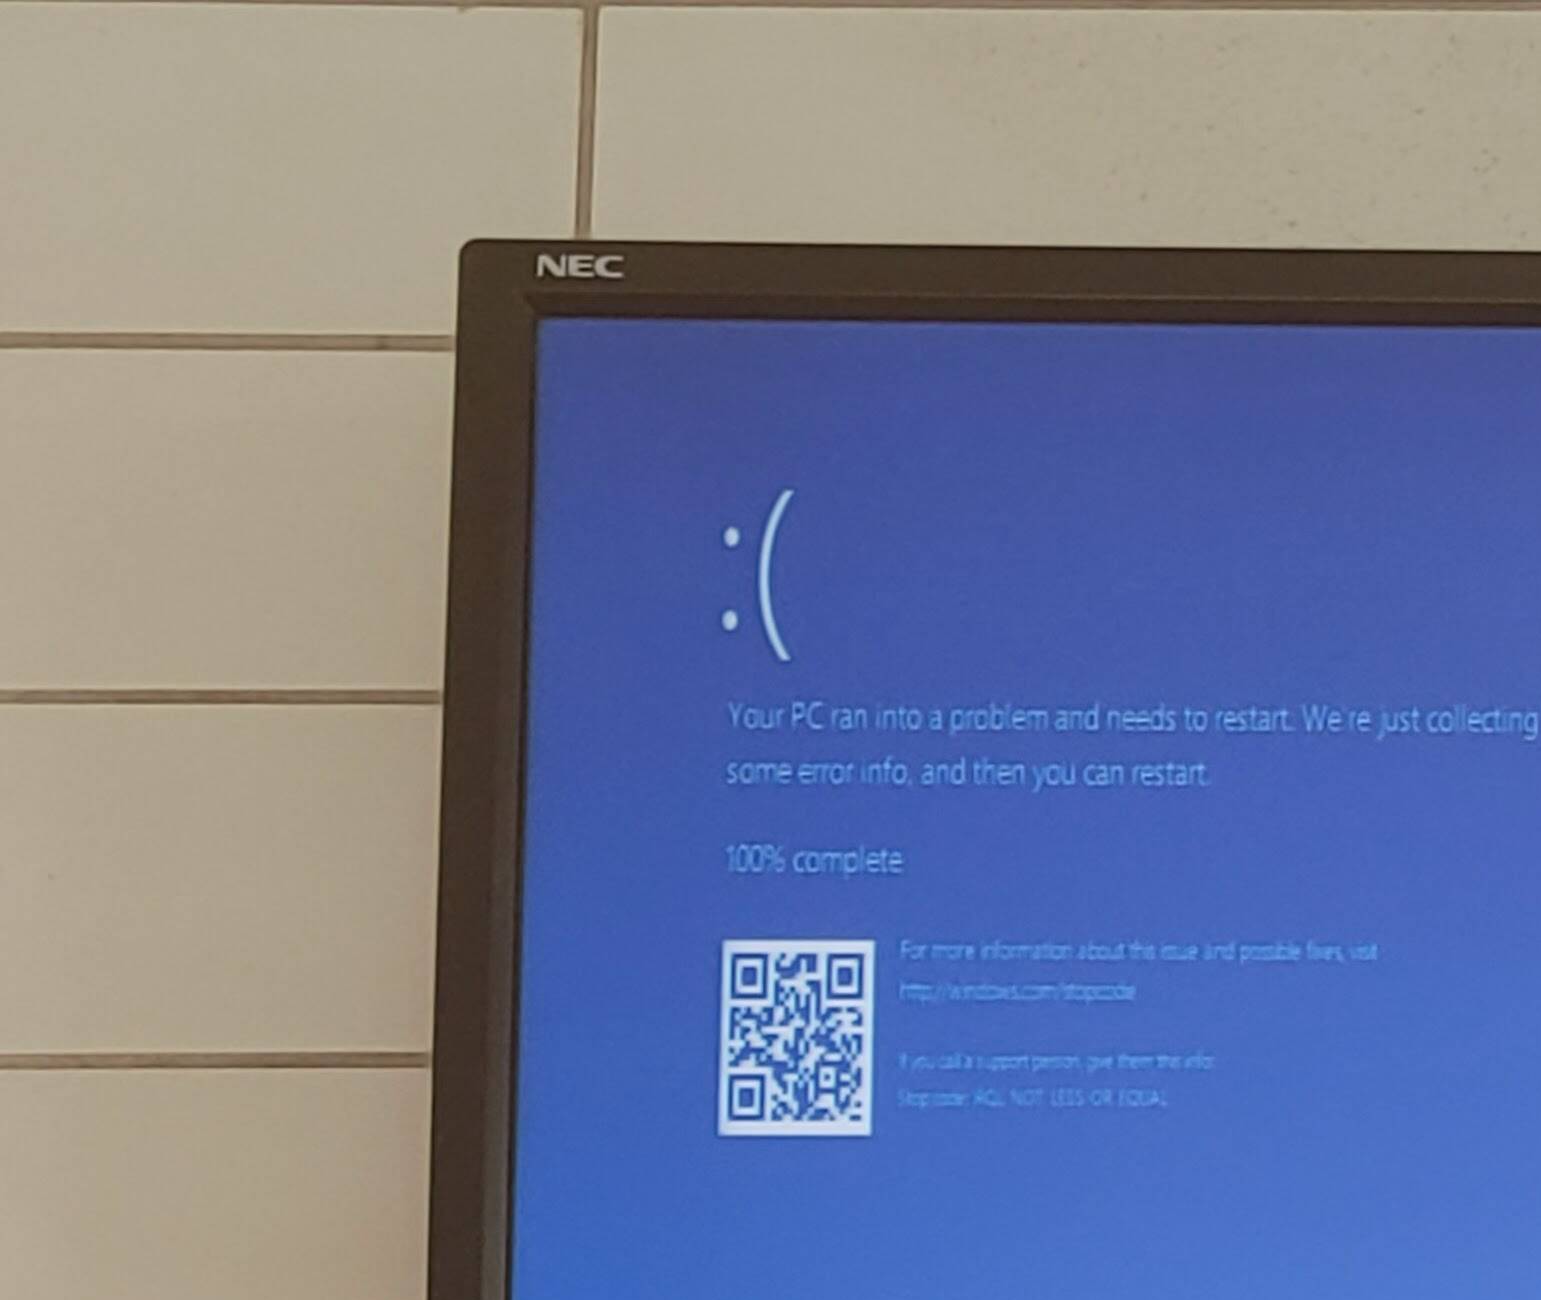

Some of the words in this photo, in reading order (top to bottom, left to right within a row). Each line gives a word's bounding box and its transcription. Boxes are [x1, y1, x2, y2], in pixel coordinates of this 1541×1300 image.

[537, 253, 624, 278] NEC
[728, 700, 785, 731] Your
[791, 700, 824, 731] PC
[832, 707, 868, 731] ran
[875, 703, 922, 731] into
[928, 708, 943, 731] a
[949, 704, 1050, 736] problem
[1055, 704, 1099, 731] and
[1106, 703, 1176, 733] needs
[1184, 705, 1207, 733] to
[1215, 706, 1296, 733] restart.
[1304, 704, 1371, 733] We're
[1376, 704, 1421, 741] just
[1426, 703, 1539, 741] collecting
[726, 761, 793, 785] some
[798, 761, 854, 785] error
[861, 756, 912, 788] info,
[920, 758, 966, 786] and
[973, 758, 1026, 786] then
[1032, 762, 1076, 793] you
[1083, 763, 1124, 786] can
[1132, 761, 1211, 787] restart.
[725, 843, 785, 874] 100%
[792, 846, 904, 880] complete
[900, 939, 928, 961] For
[931, 944, 974, 961] more
[979, 940, 1072, 962] information
